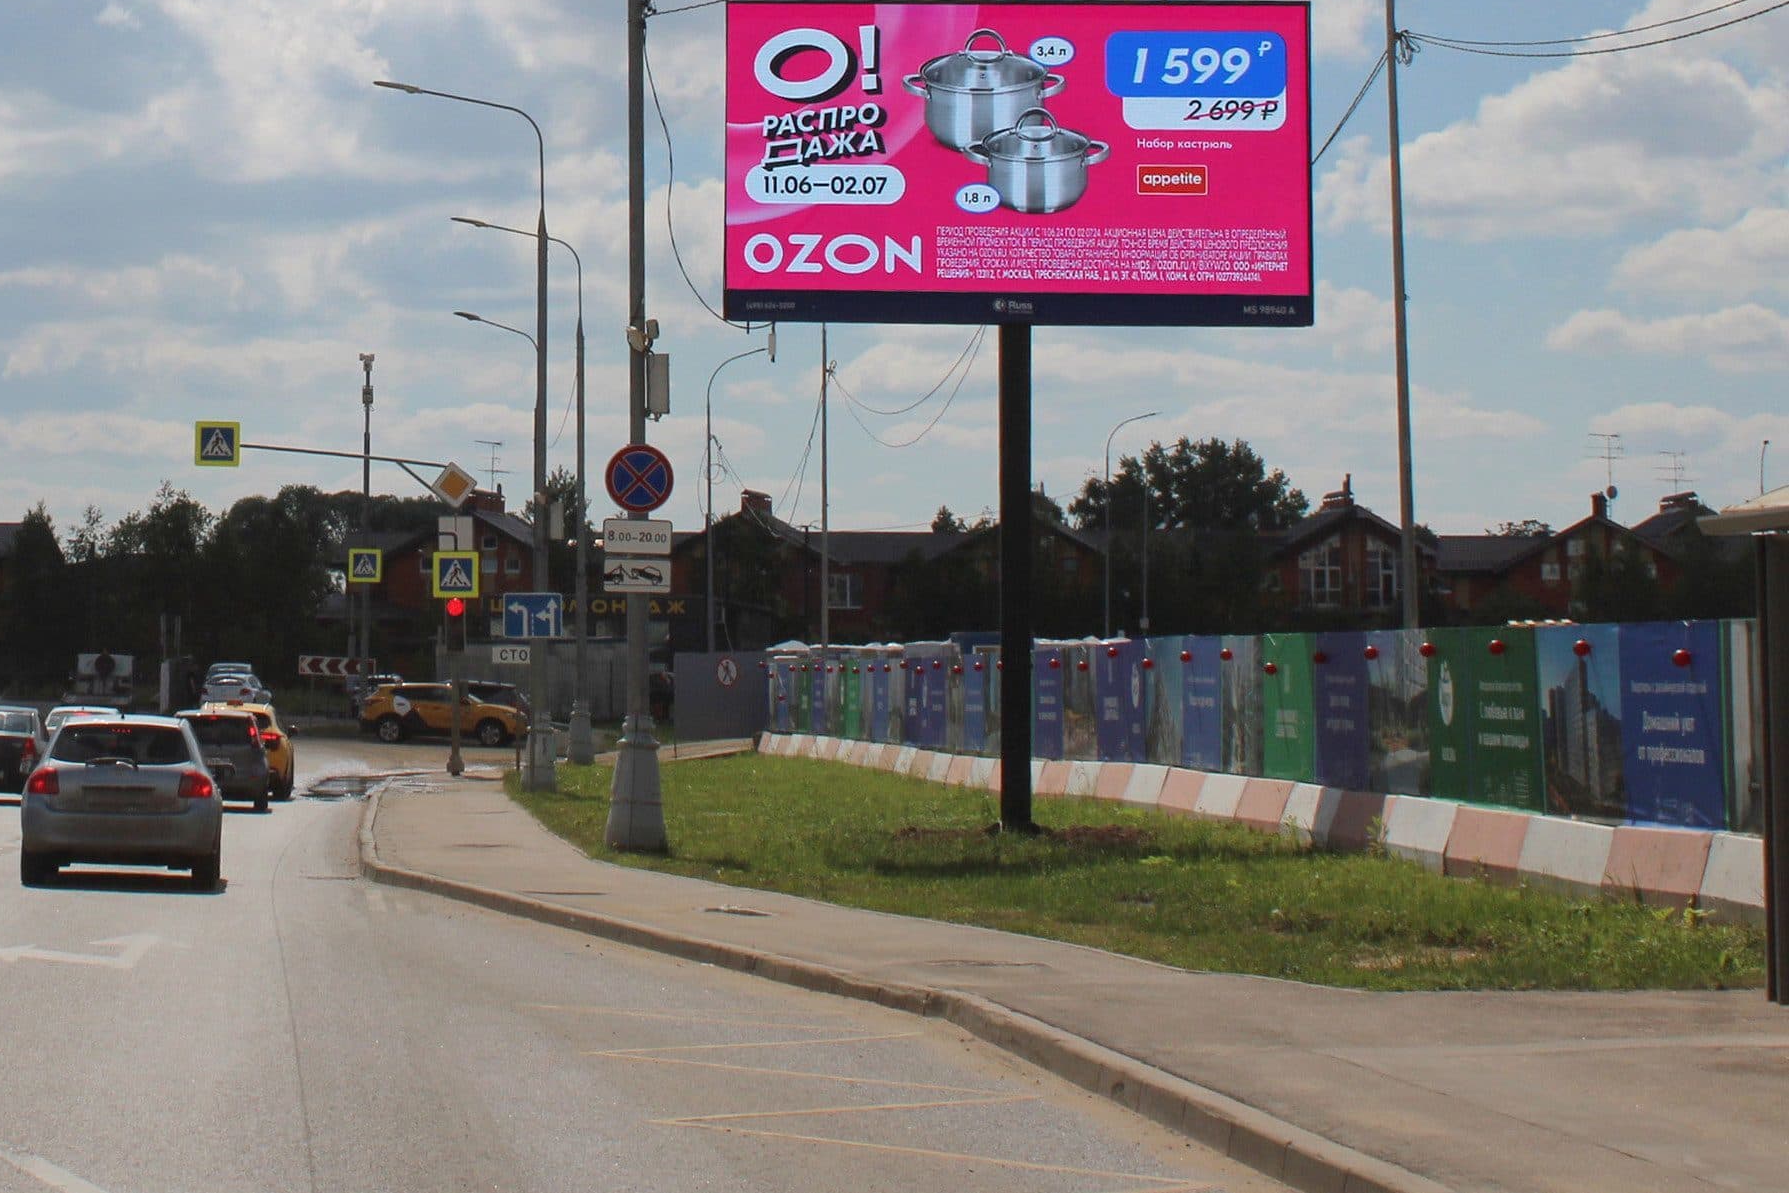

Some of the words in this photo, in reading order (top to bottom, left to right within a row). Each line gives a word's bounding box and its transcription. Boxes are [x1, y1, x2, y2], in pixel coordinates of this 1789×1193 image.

[1037, 46, 1054, 57] 3,4
[1133, 48, 1149, 84] 1
[1161, 47, 1250, 85] 599
[762, 103, 883, 137] РАСПРО
[1187, 100, 1202, 120] 2
[1209, 100, 1255, 121] 699
[761, 130, 883, 169] ДАЖА
[1137, 138, 1174, 150] Набор
[1177, 140, 1232, 150] кастрюль
[1142, 172, 1203, 186] appetite
[964, 193, 978, 203] 1,8
[983, 195, 991, 203] л
[744, 233, 922, 274] OZON
